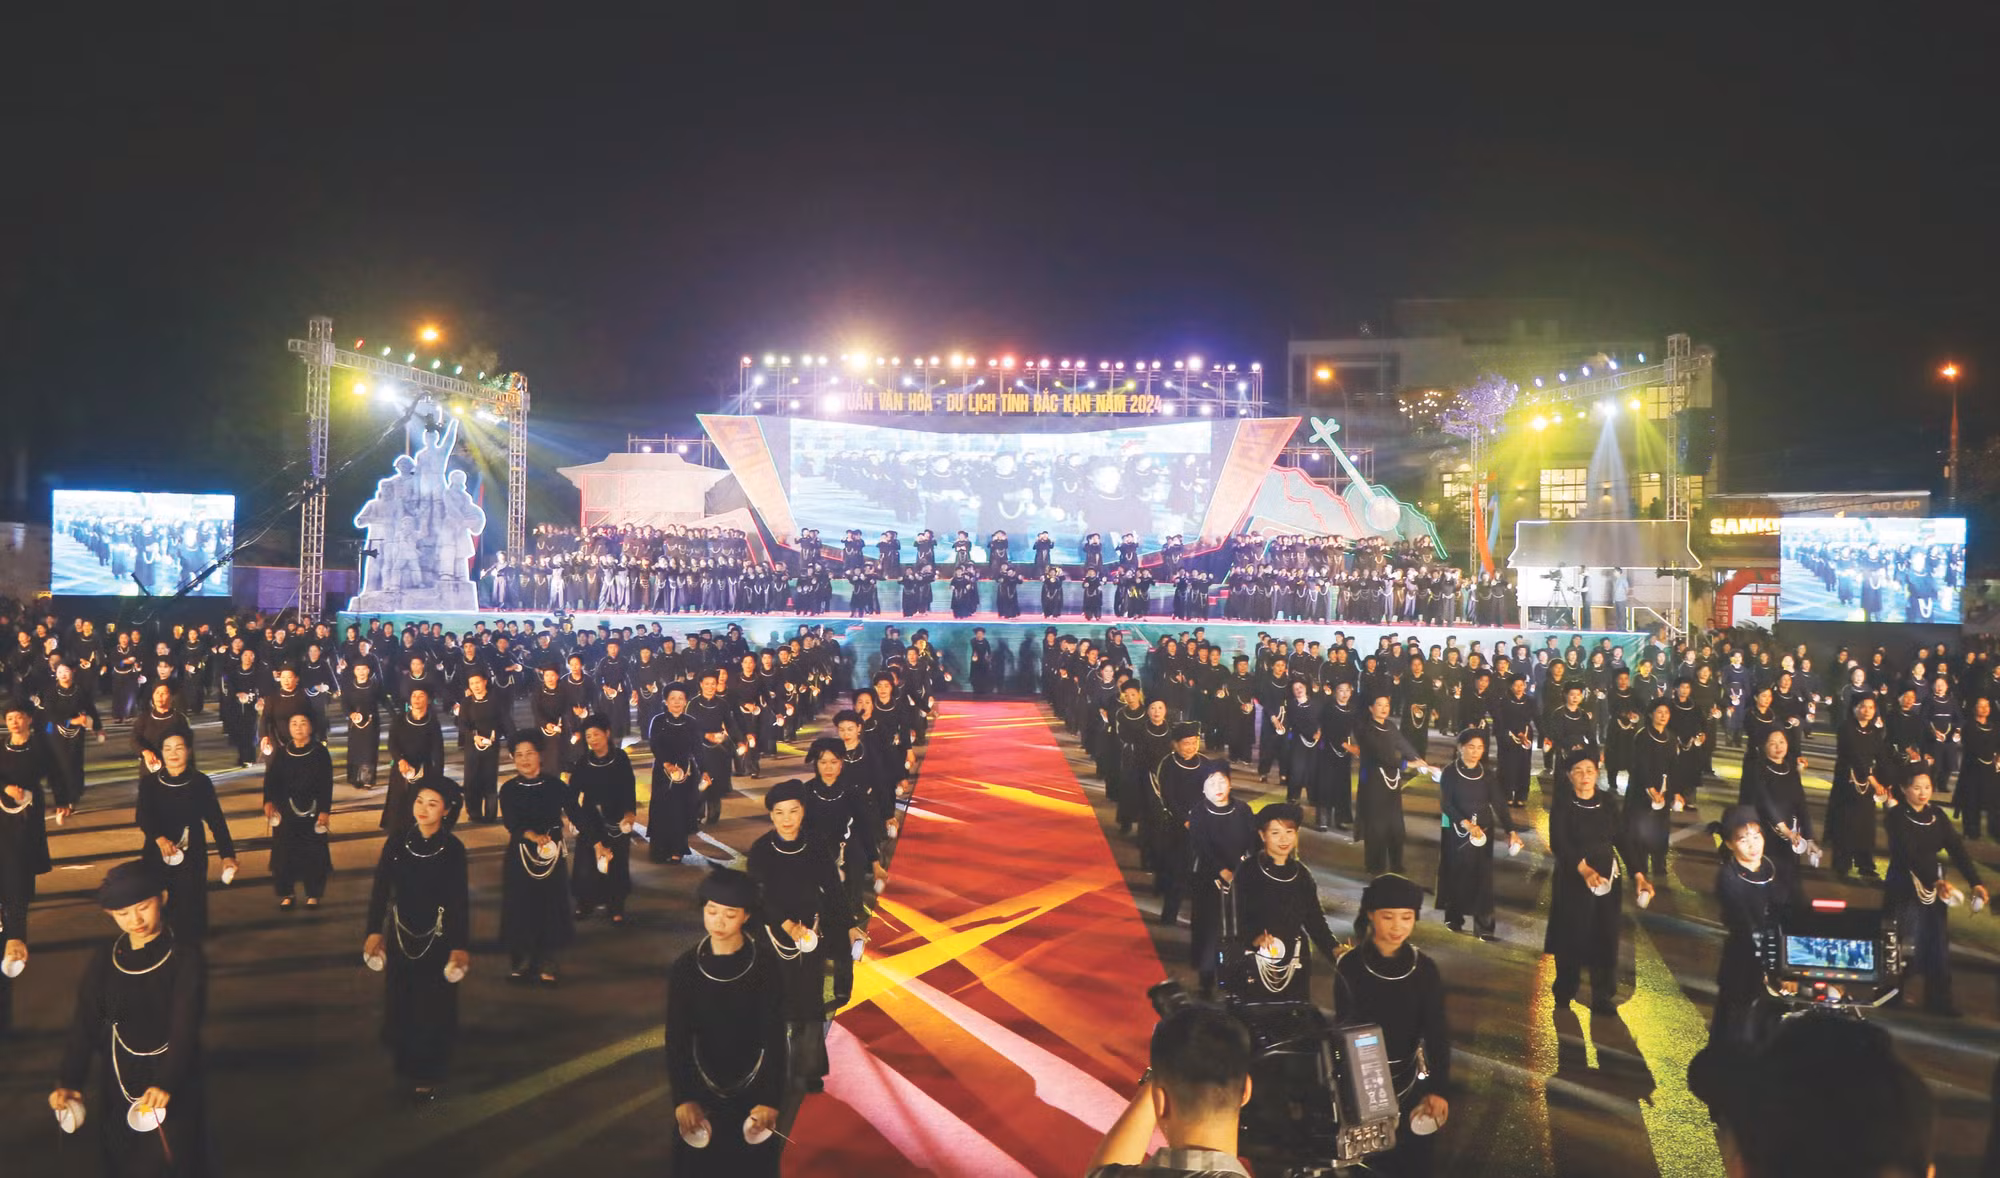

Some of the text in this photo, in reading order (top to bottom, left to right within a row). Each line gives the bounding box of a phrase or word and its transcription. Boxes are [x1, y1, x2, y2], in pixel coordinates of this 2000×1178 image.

[878, 390, 903, 411] VĂN
[908, 390, 933, 412] HÓA
[947, 393, 963, 412] DU
[968, 393, 996, 415] LỊCH
[1000, 387, 1029, 412] TỈNH
[1034, 387, 1059, 412] BẮC
[1063, 394, 1091, 416] KẠN
[1095, 390, 1127, 412] NĂM
[1130, 395, 1162, 412] 2024
